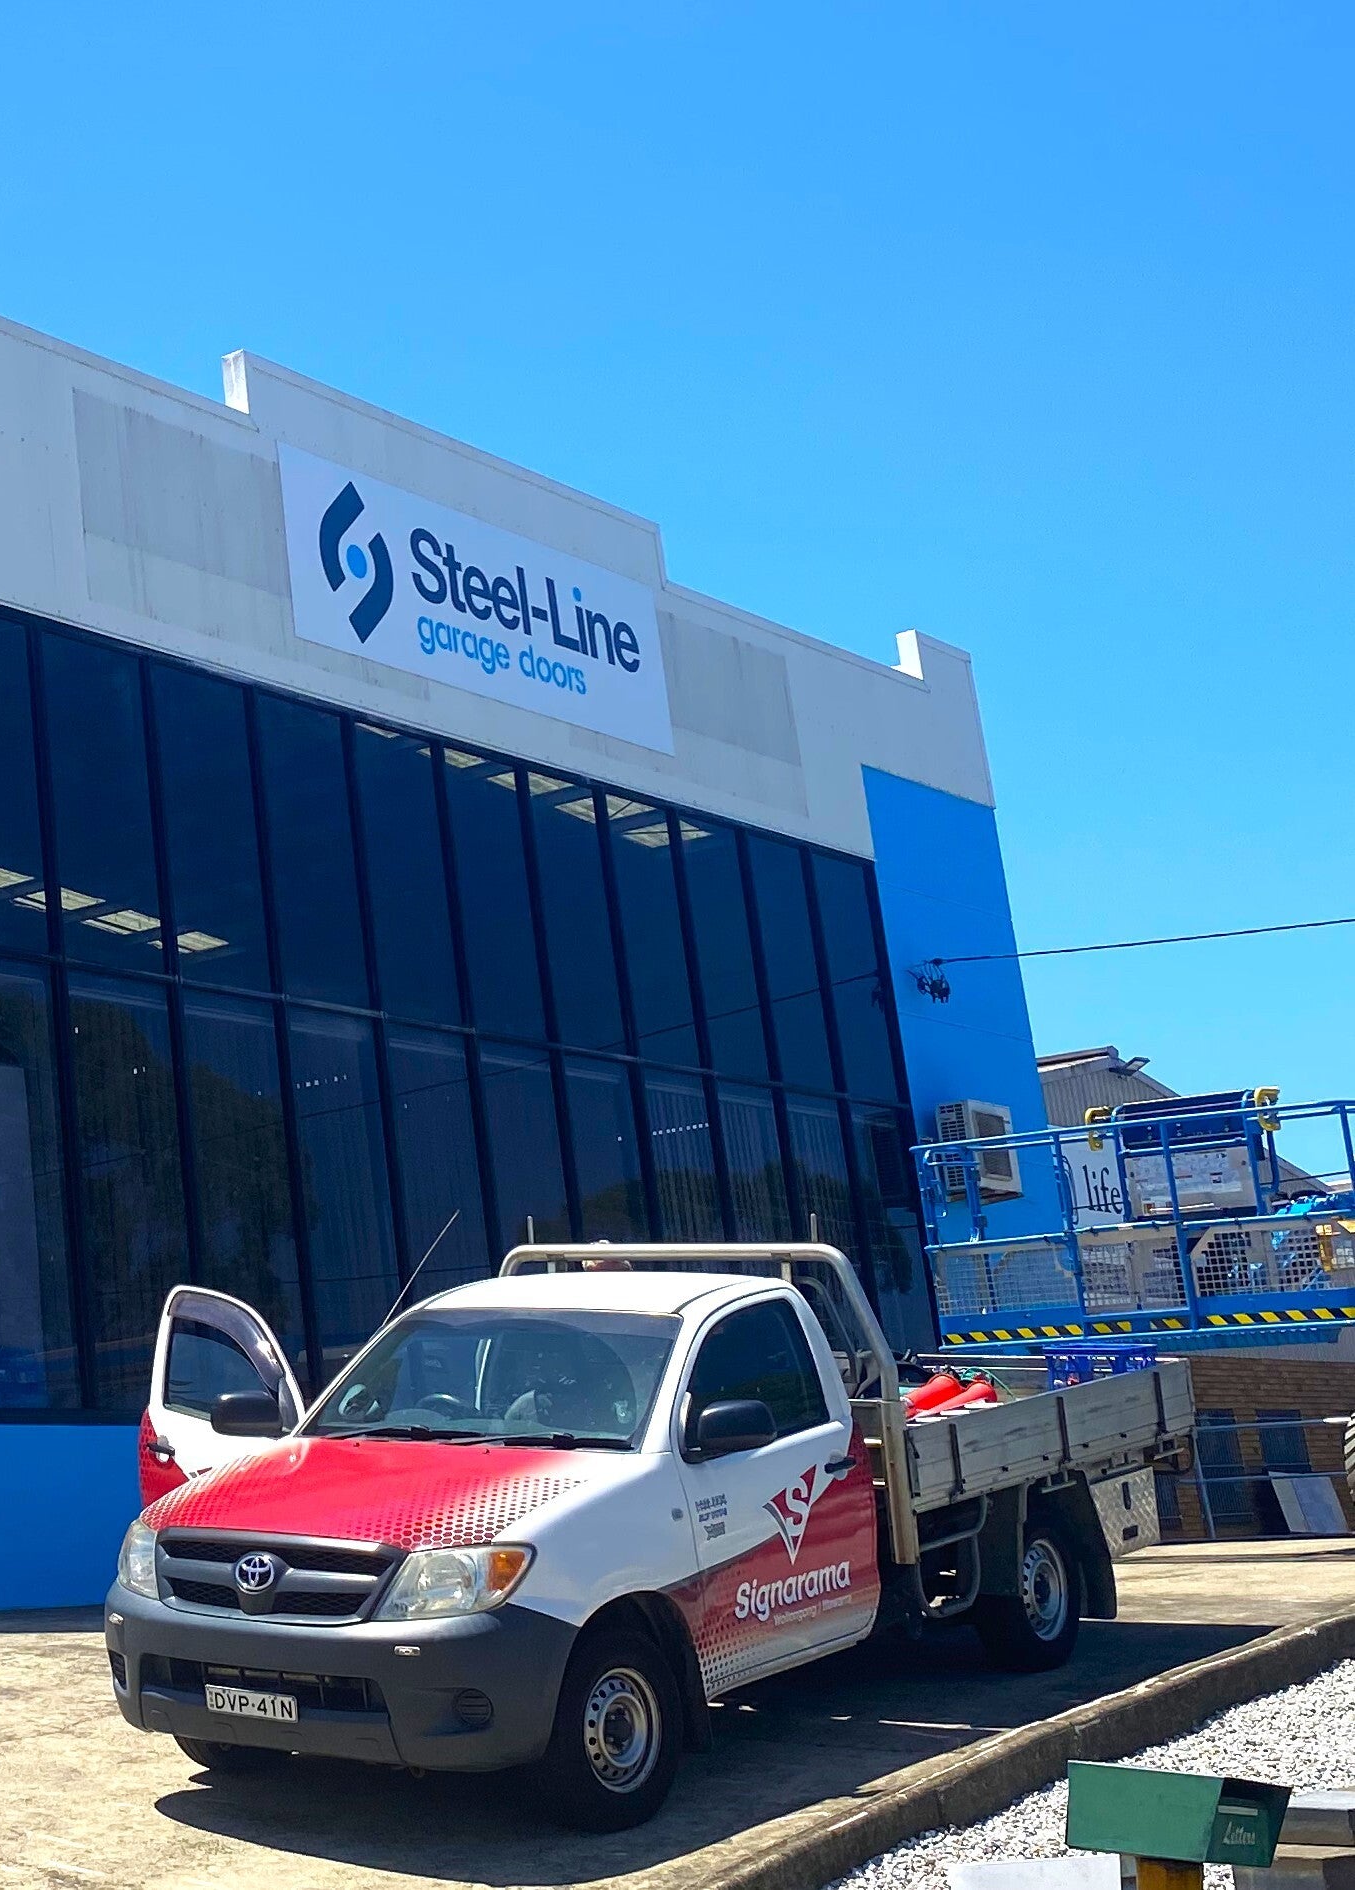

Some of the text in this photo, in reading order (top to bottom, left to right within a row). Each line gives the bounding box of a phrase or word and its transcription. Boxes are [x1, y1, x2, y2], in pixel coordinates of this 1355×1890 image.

[409, 528, 641, 673] Steel-Line
[416, 615, 587, 695] garage doors
[1082, 1164, 1123, 1215] life
[734, 1560, 851, 1622] Signarama
